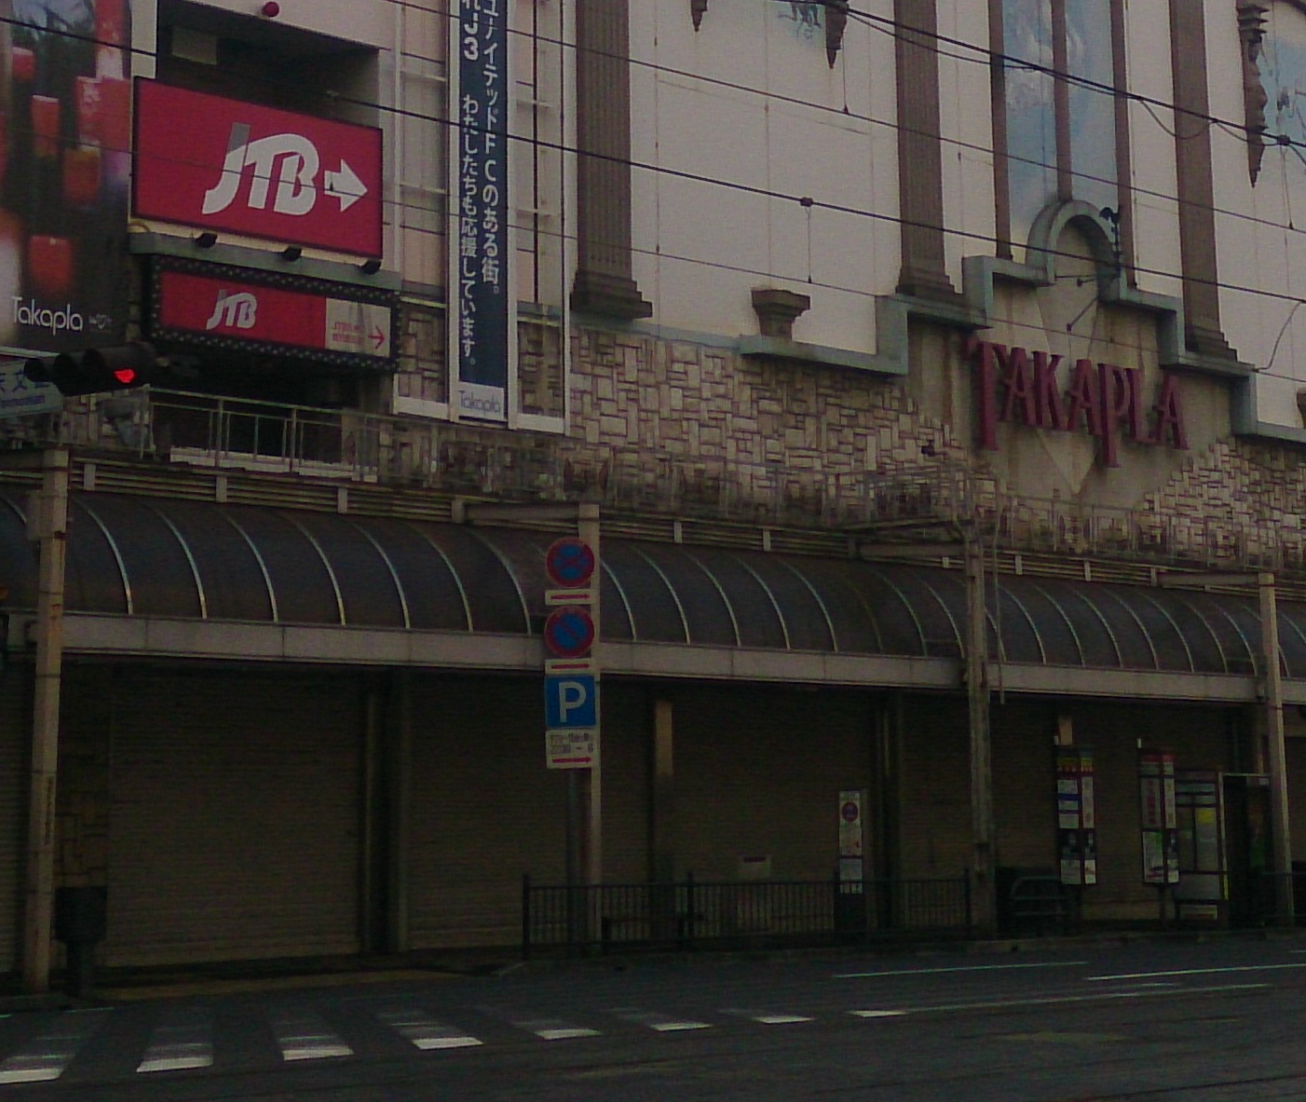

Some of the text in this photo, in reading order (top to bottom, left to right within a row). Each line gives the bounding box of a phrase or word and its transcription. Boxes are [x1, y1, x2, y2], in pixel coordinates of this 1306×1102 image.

[202, 122, 320, 216] JTB
[12, 296, 84, 336] Takapla
[205, 289, 258, 331] JTB
[459, 389, 501, 415] Takapla
[961, 334, 1189, 469] TAKAPLA
[558, 681, 587, 724] P
